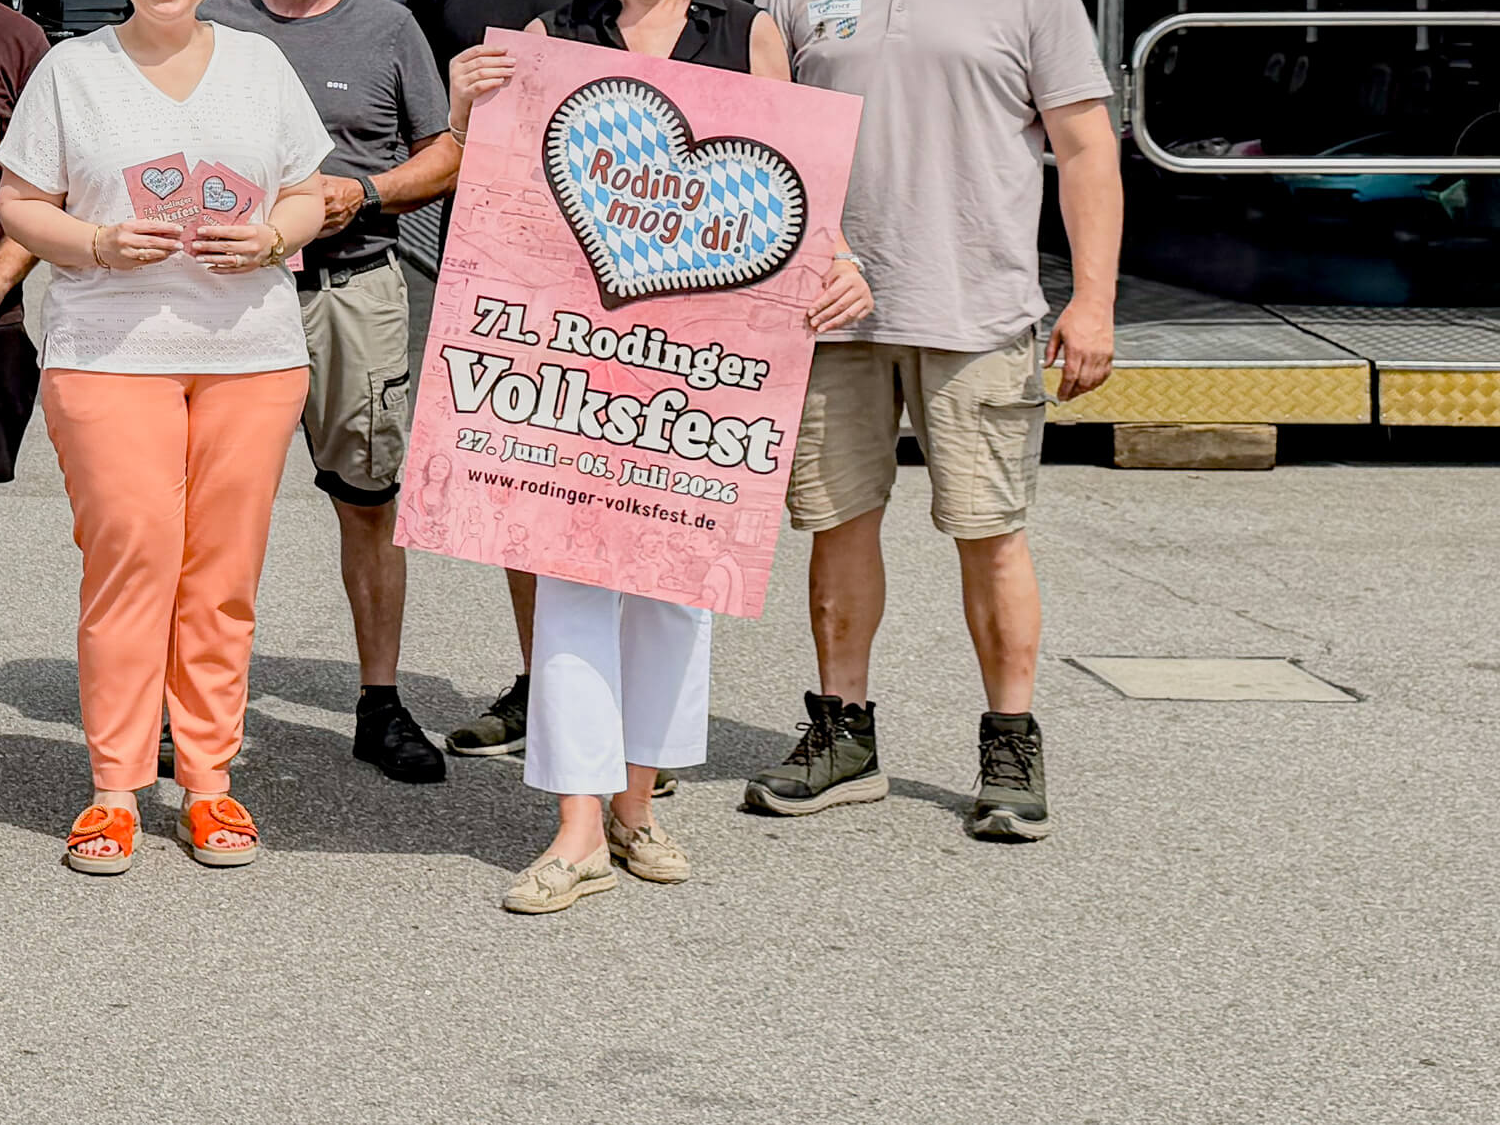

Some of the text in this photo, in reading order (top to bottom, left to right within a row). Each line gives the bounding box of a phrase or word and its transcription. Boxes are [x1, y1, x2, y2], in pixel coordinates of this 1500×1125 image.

[589, 148, 705, 211] Roding
[606, 198, 748, 253] mog di!
[470, 295, 770, 391] 71. Rodinger
[440, 345, 785, 474] Volksfest
[456, 428, 496, 456] 27.
[500, 435, 557, 468] Juni
[577, 452, 614, 480] 05.
[617, 459, 669, 491] Juli
[672, 473, 739, 505] 2026
[468, 468, 717, 531] www.rodinger-volksfest.de
